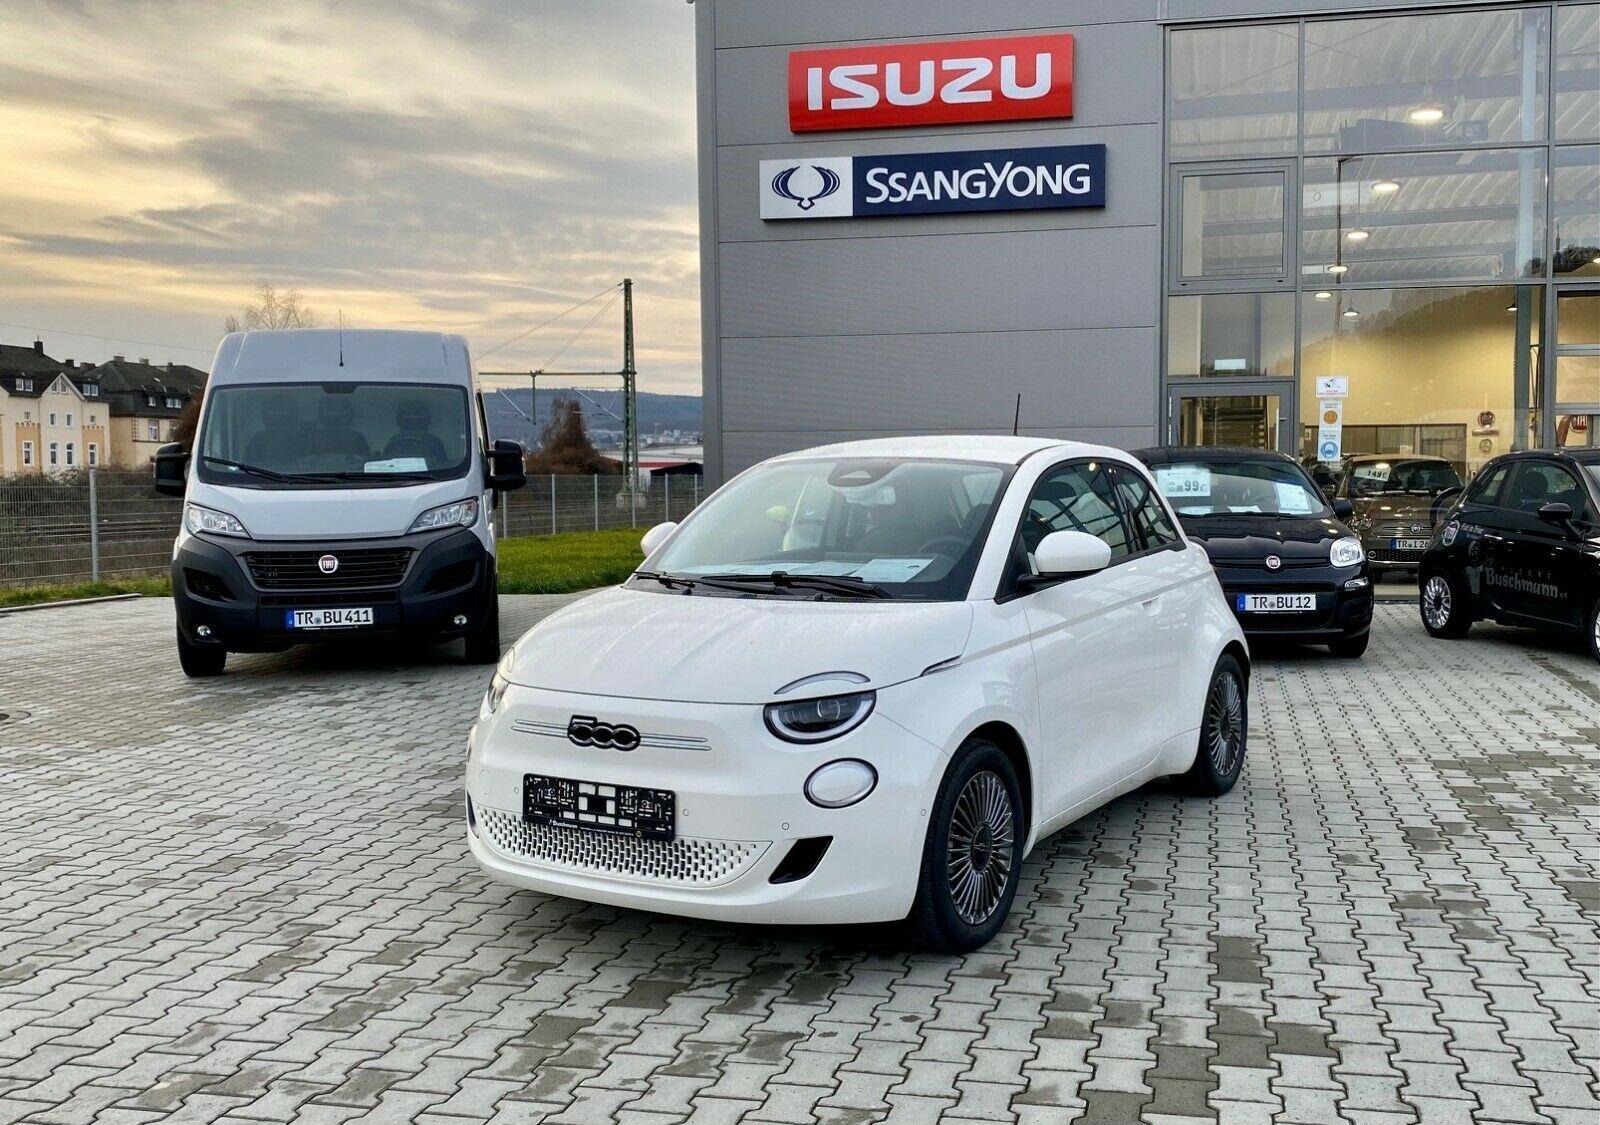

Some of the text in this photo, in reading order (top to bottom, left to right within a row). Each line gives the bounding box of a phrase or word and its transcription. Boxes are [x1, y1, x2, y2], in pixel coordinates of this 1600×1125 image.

[808, 53, 1051, 111] ISUZU
[1398, 540, 1407, 548] TR
[323, 560, 334, 569] FIAT
[1485, 567, 1559, 598] Buschmann
[1252, 596, 1311, 609] TR BU 12
[295, 610, 371, 625] TR BU 411
[567, 715, 641, 751] 500
